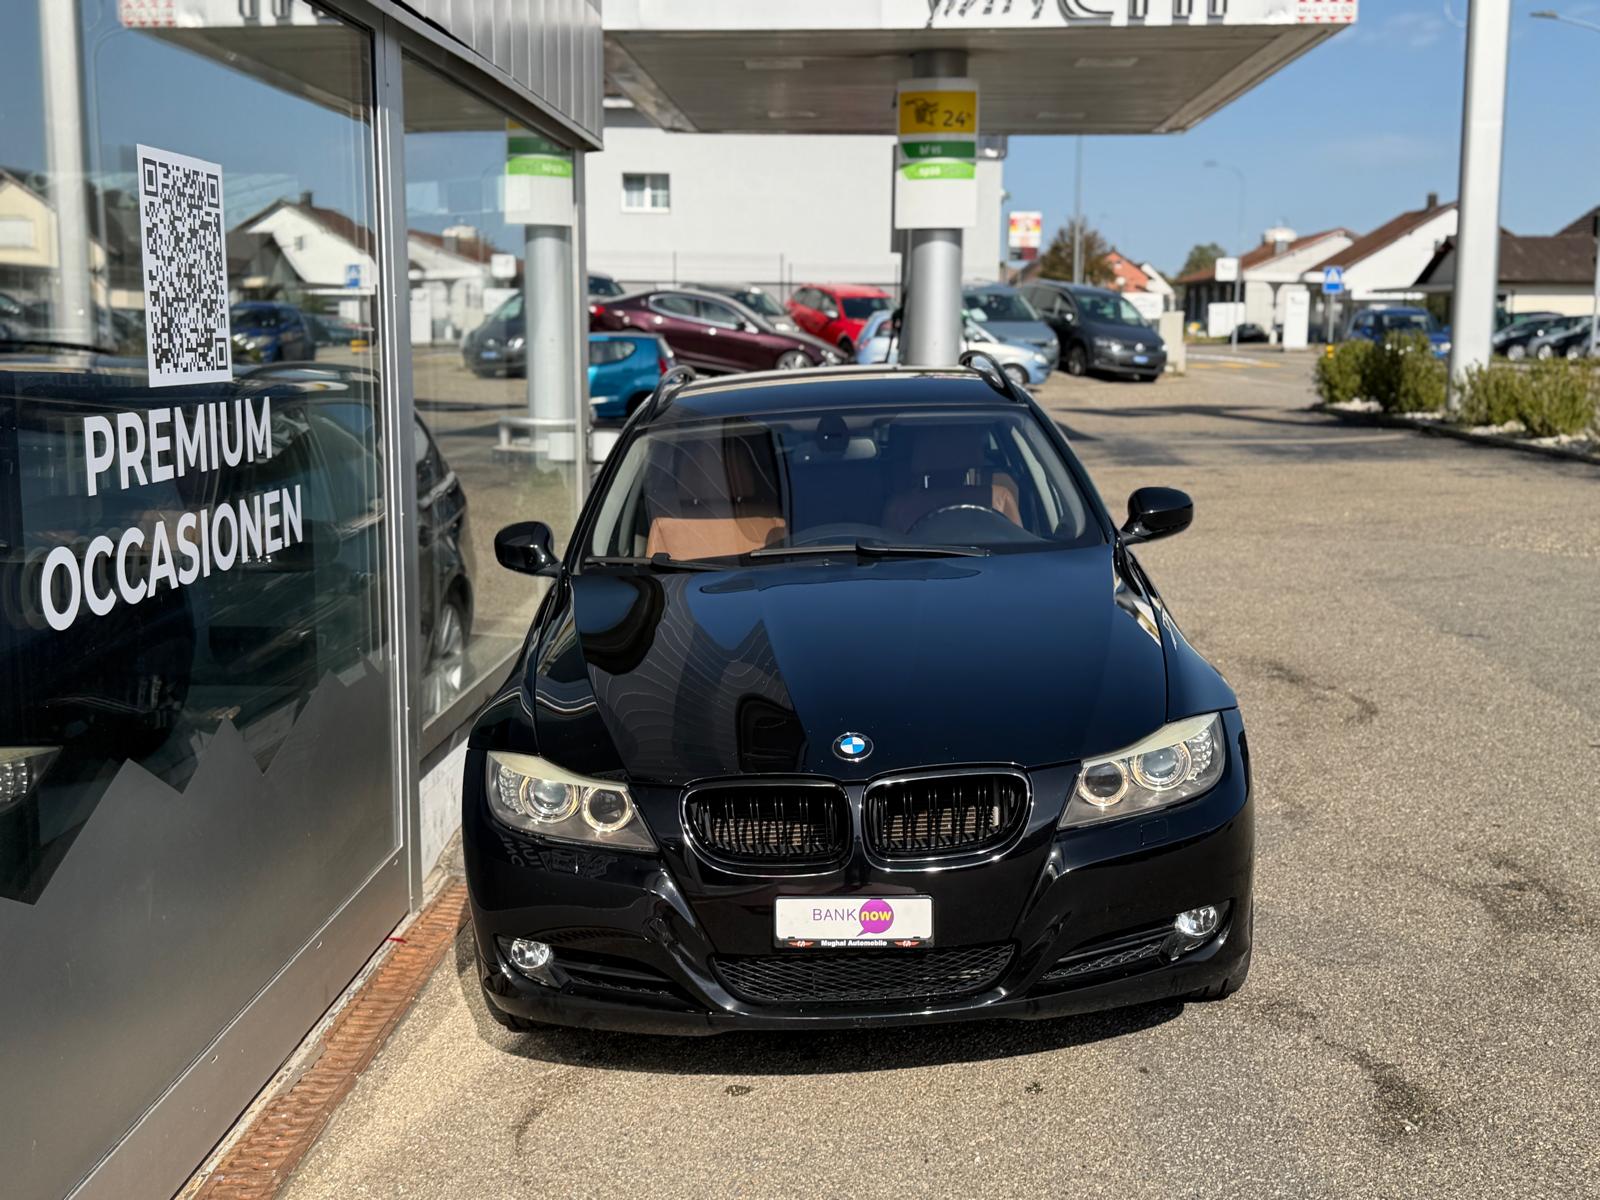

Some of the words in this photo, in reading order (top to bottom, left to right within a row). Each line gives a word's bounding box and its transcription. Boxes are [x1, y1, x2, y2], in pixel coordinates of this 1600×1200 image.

[83, 396, 273, 497] PREMIUM
[40, 484, 303, 632] OCCASIONEN
[812, 908, 857, 921] BANK
[860, 910, 892, 922] now
[820, 939, 847, 947] Mughal
[848, 939, 887, 947] Automobile
